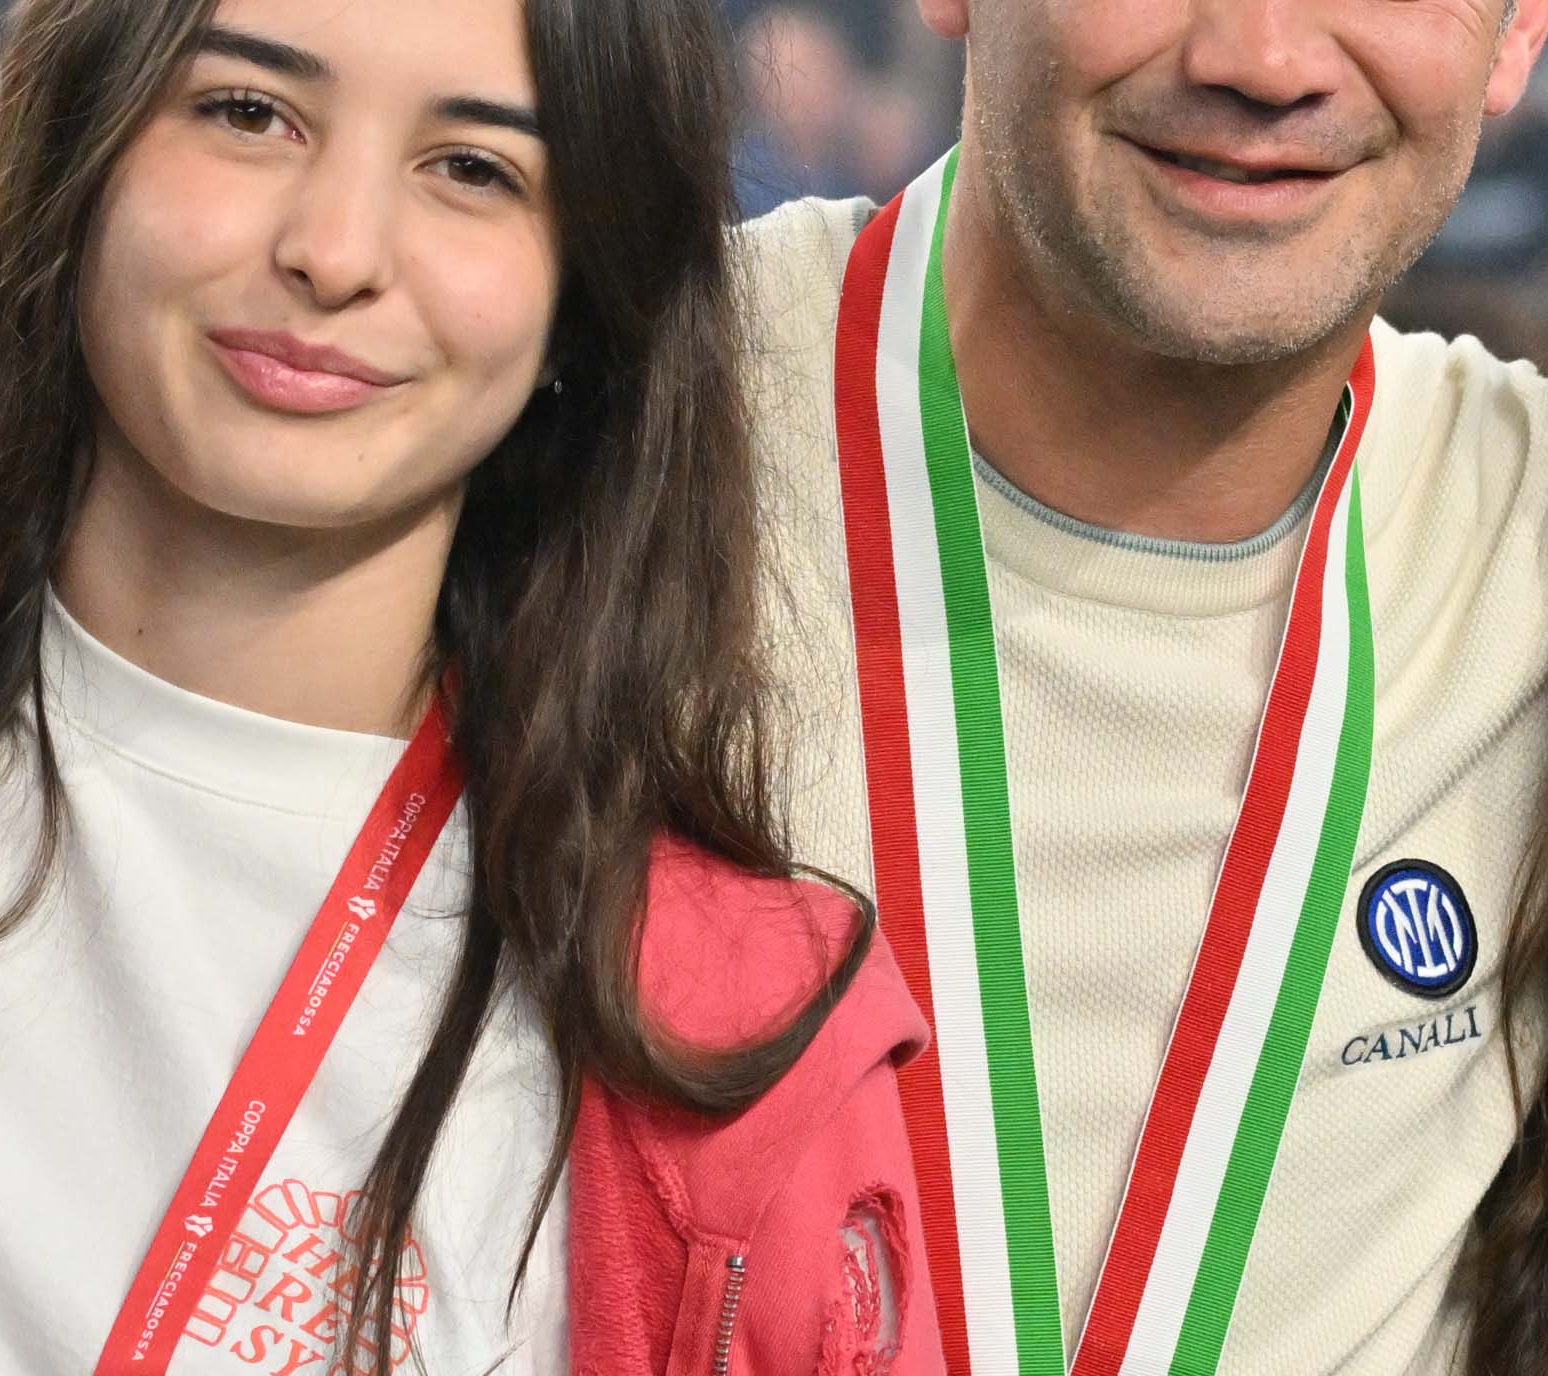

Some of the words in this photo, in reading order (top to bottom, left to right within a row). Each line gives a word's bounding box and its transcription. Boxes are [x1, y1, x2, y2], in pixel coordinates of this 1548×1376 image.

[390, 793, 426, 841] COPPA
[364, 842, 400, 890] ITALIA
[293, 924, 360, 1035] FRECCIAROSSA
[1341, 1007, 1483, 1067] CANALI
[227, 1100, 265, 1153] COPPA
[201, 1157, 239, 1207] ITALIA
[132, 1242, 196, 1361] FRECCIAROSSA
